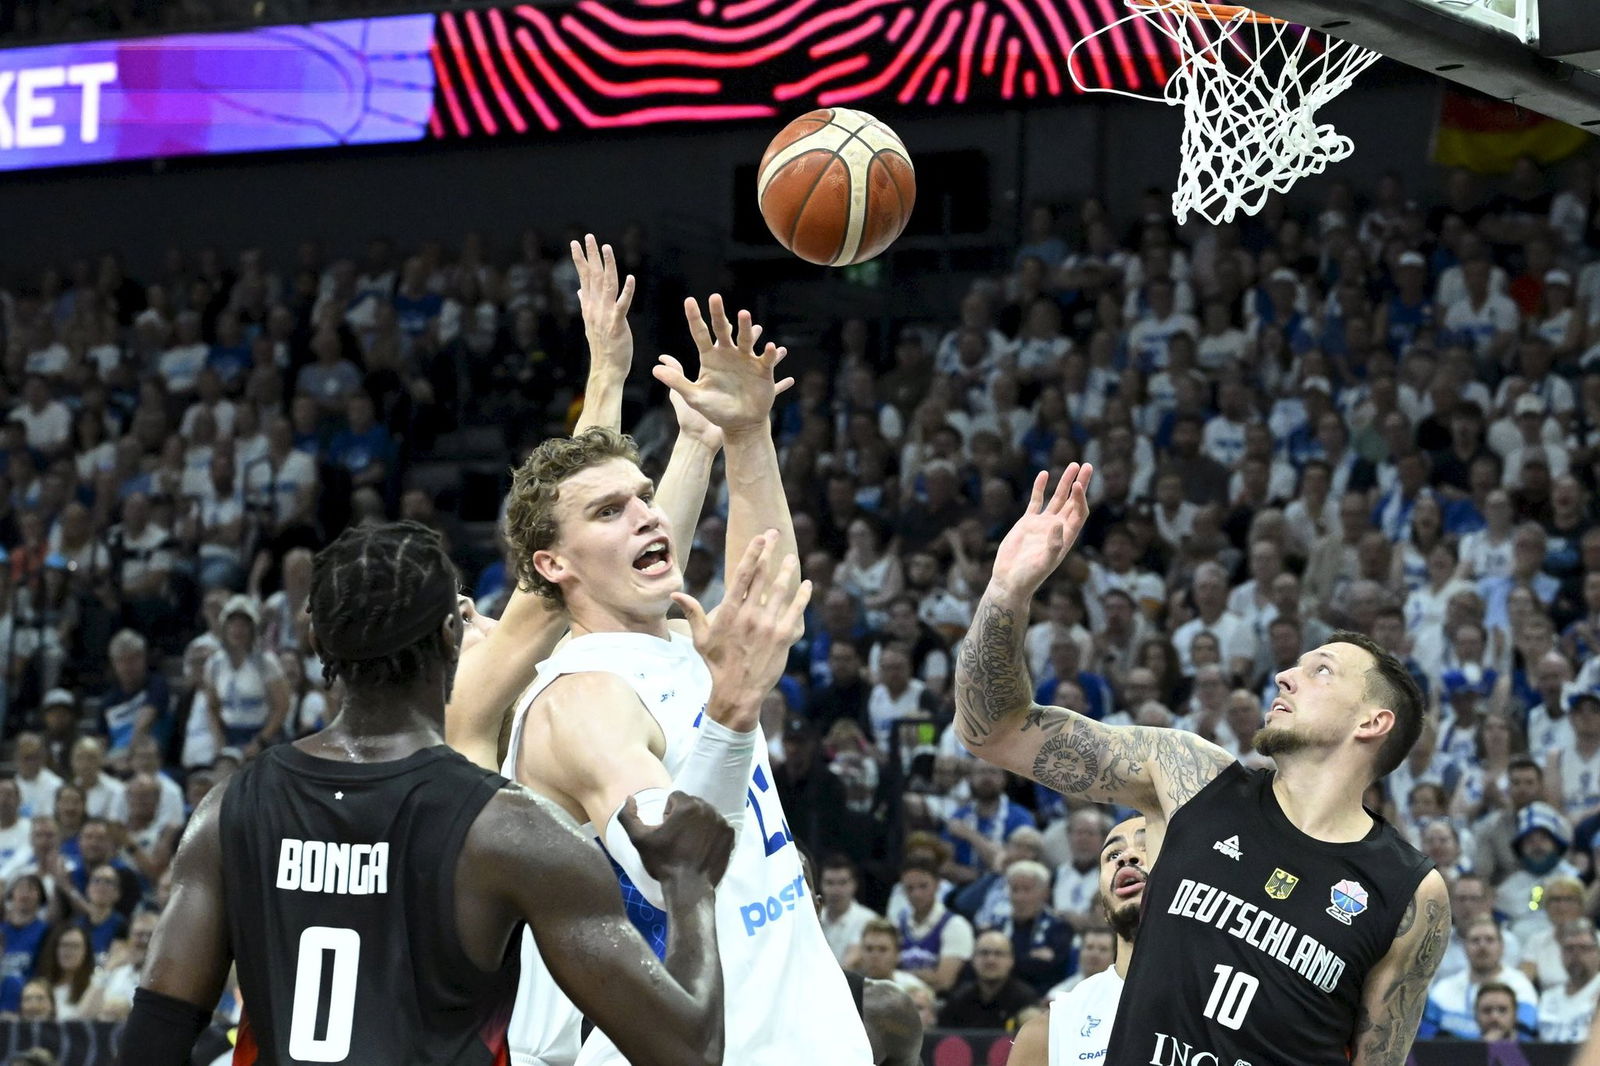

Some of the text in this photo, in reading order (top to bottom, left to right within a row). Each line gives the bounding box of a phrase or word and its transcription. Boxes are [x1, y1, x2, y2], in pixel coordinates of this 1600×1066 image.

[276, 838, 389, 895] BONGA
[1167, 878, 1347, 994] DEUTSCHLAND
[288, 926, 361, 1063] 0
[1202, 963, 1260, 1031] 10
